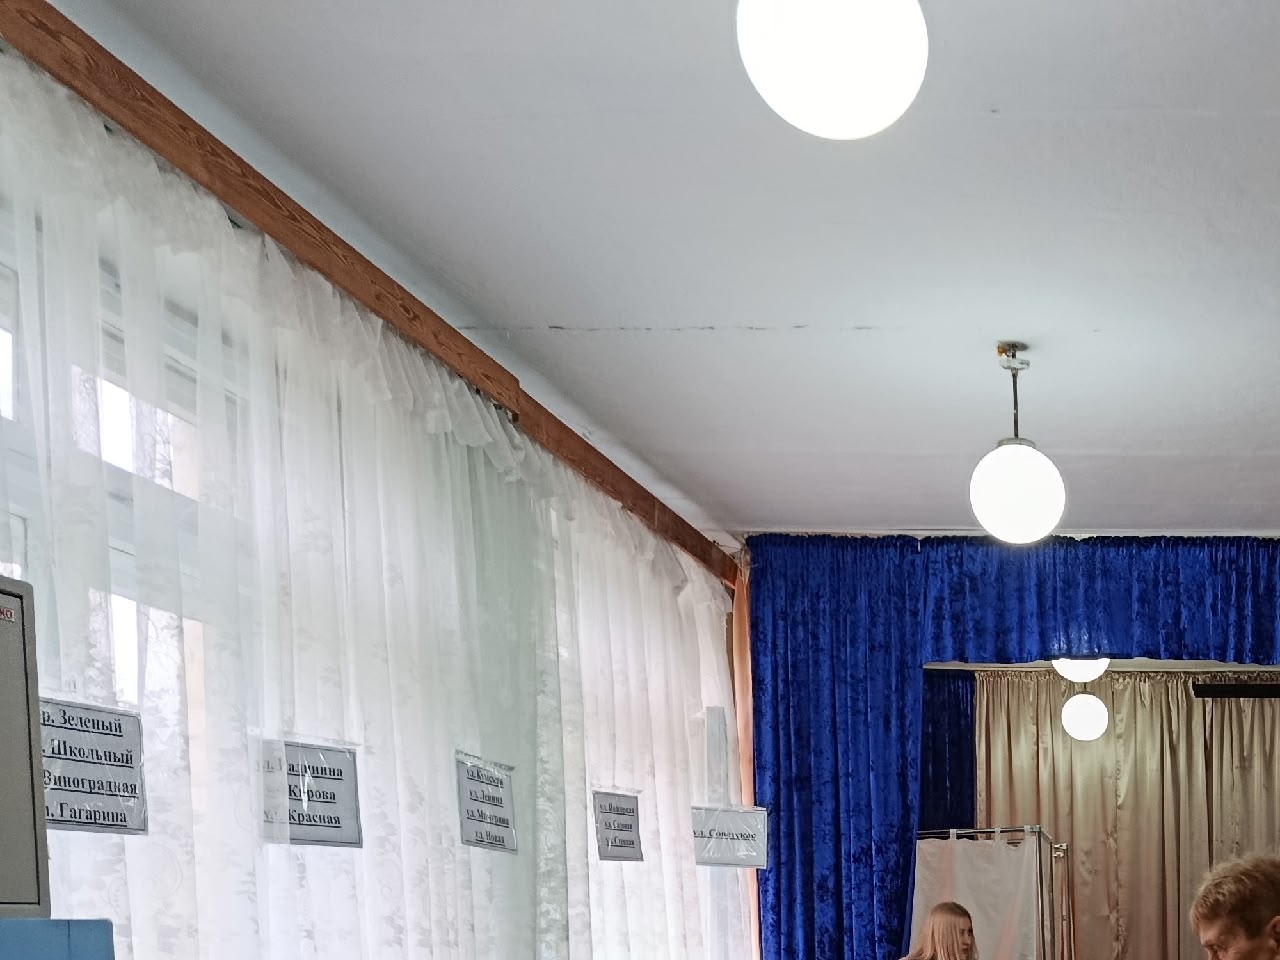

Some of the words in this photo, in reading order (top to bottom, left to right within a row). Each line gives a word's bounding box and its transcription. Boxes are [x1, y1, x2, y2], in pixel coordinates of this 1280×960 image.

[59, 708, 123, 733] Зеленый
[51, 738, 133, 765] Школьный
[43, 769, 138, 795] Виноградная
[59, 802, 128, 823] Гагарина
[288, 808, 341, 826] Красная
